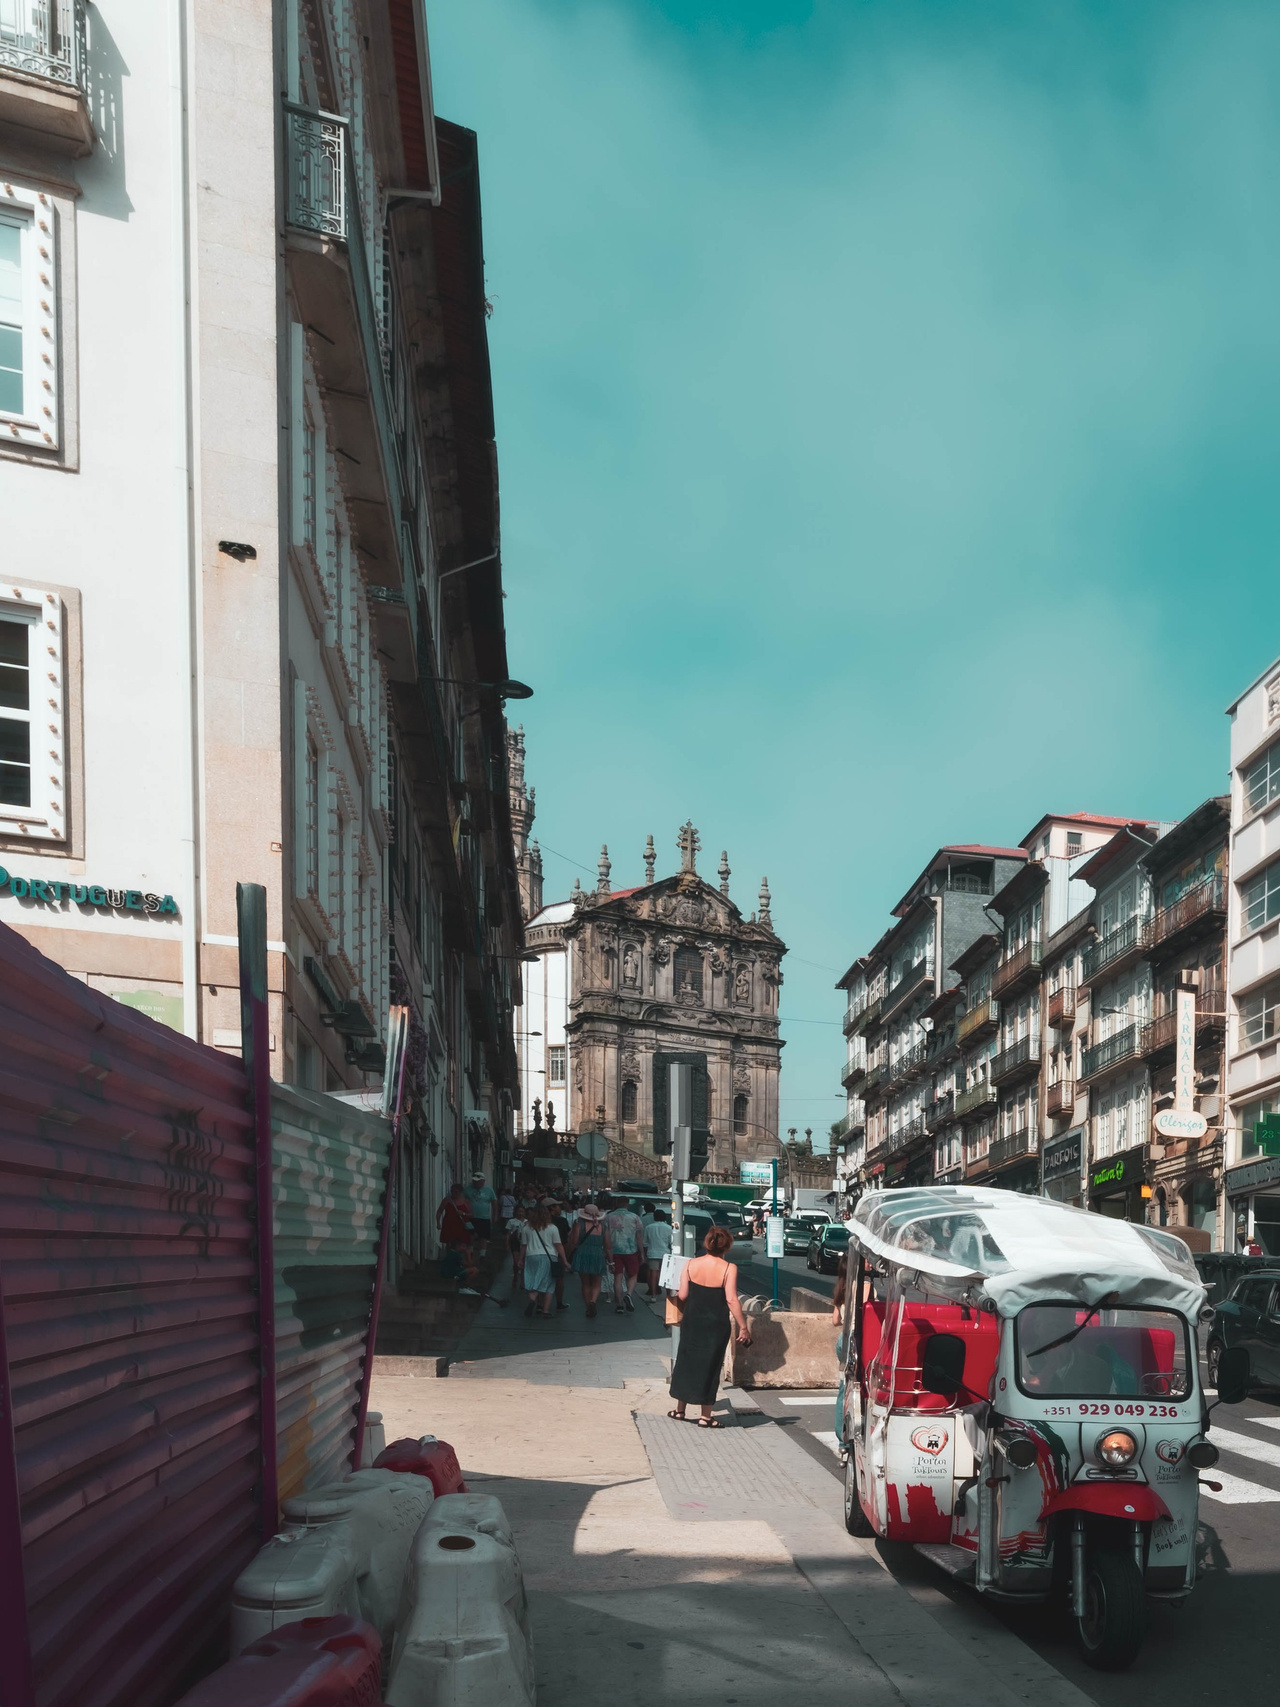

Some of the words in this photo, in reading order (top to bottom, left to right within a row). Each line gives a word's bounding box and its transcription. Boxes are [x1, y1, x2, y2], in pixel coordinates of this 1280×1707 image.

[1179, 999, 1193, 1098] FARMÁCIA
[1159, 1114, 1204, 1133] Clérigos
[1044, 1144, 1080, 1171] PARFOIS
[1043, 1406, 1071, 1416] +351
[1078, 1403, 1110, 1416] 929
[1114, 1404, 1145, 1416] 049
[1148, 1405, 1178, 1418] 236
